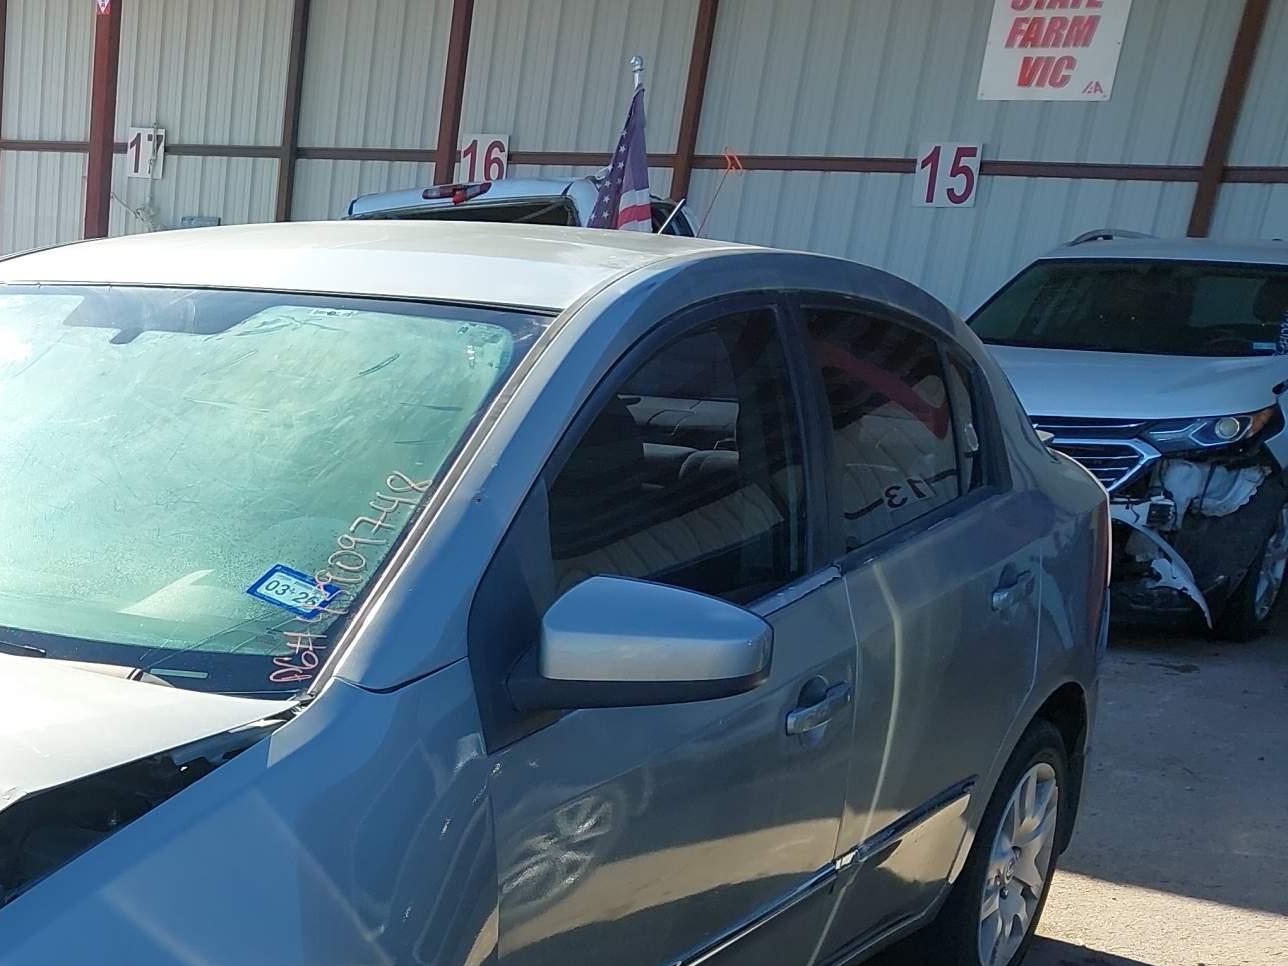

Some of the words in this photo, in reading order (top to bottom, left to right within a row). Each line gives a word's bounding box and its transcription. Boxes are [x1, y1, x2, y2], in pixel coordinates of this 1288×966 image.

[1005, 15, 1102, 48] FARM
[1017, 55, 1078, 88] VIC
[129, 132, 164, 173] 17
[463, 139, 506, 183] 16
[921, 146, 978, 204] 15
[264, 579, 290, 596] 03
